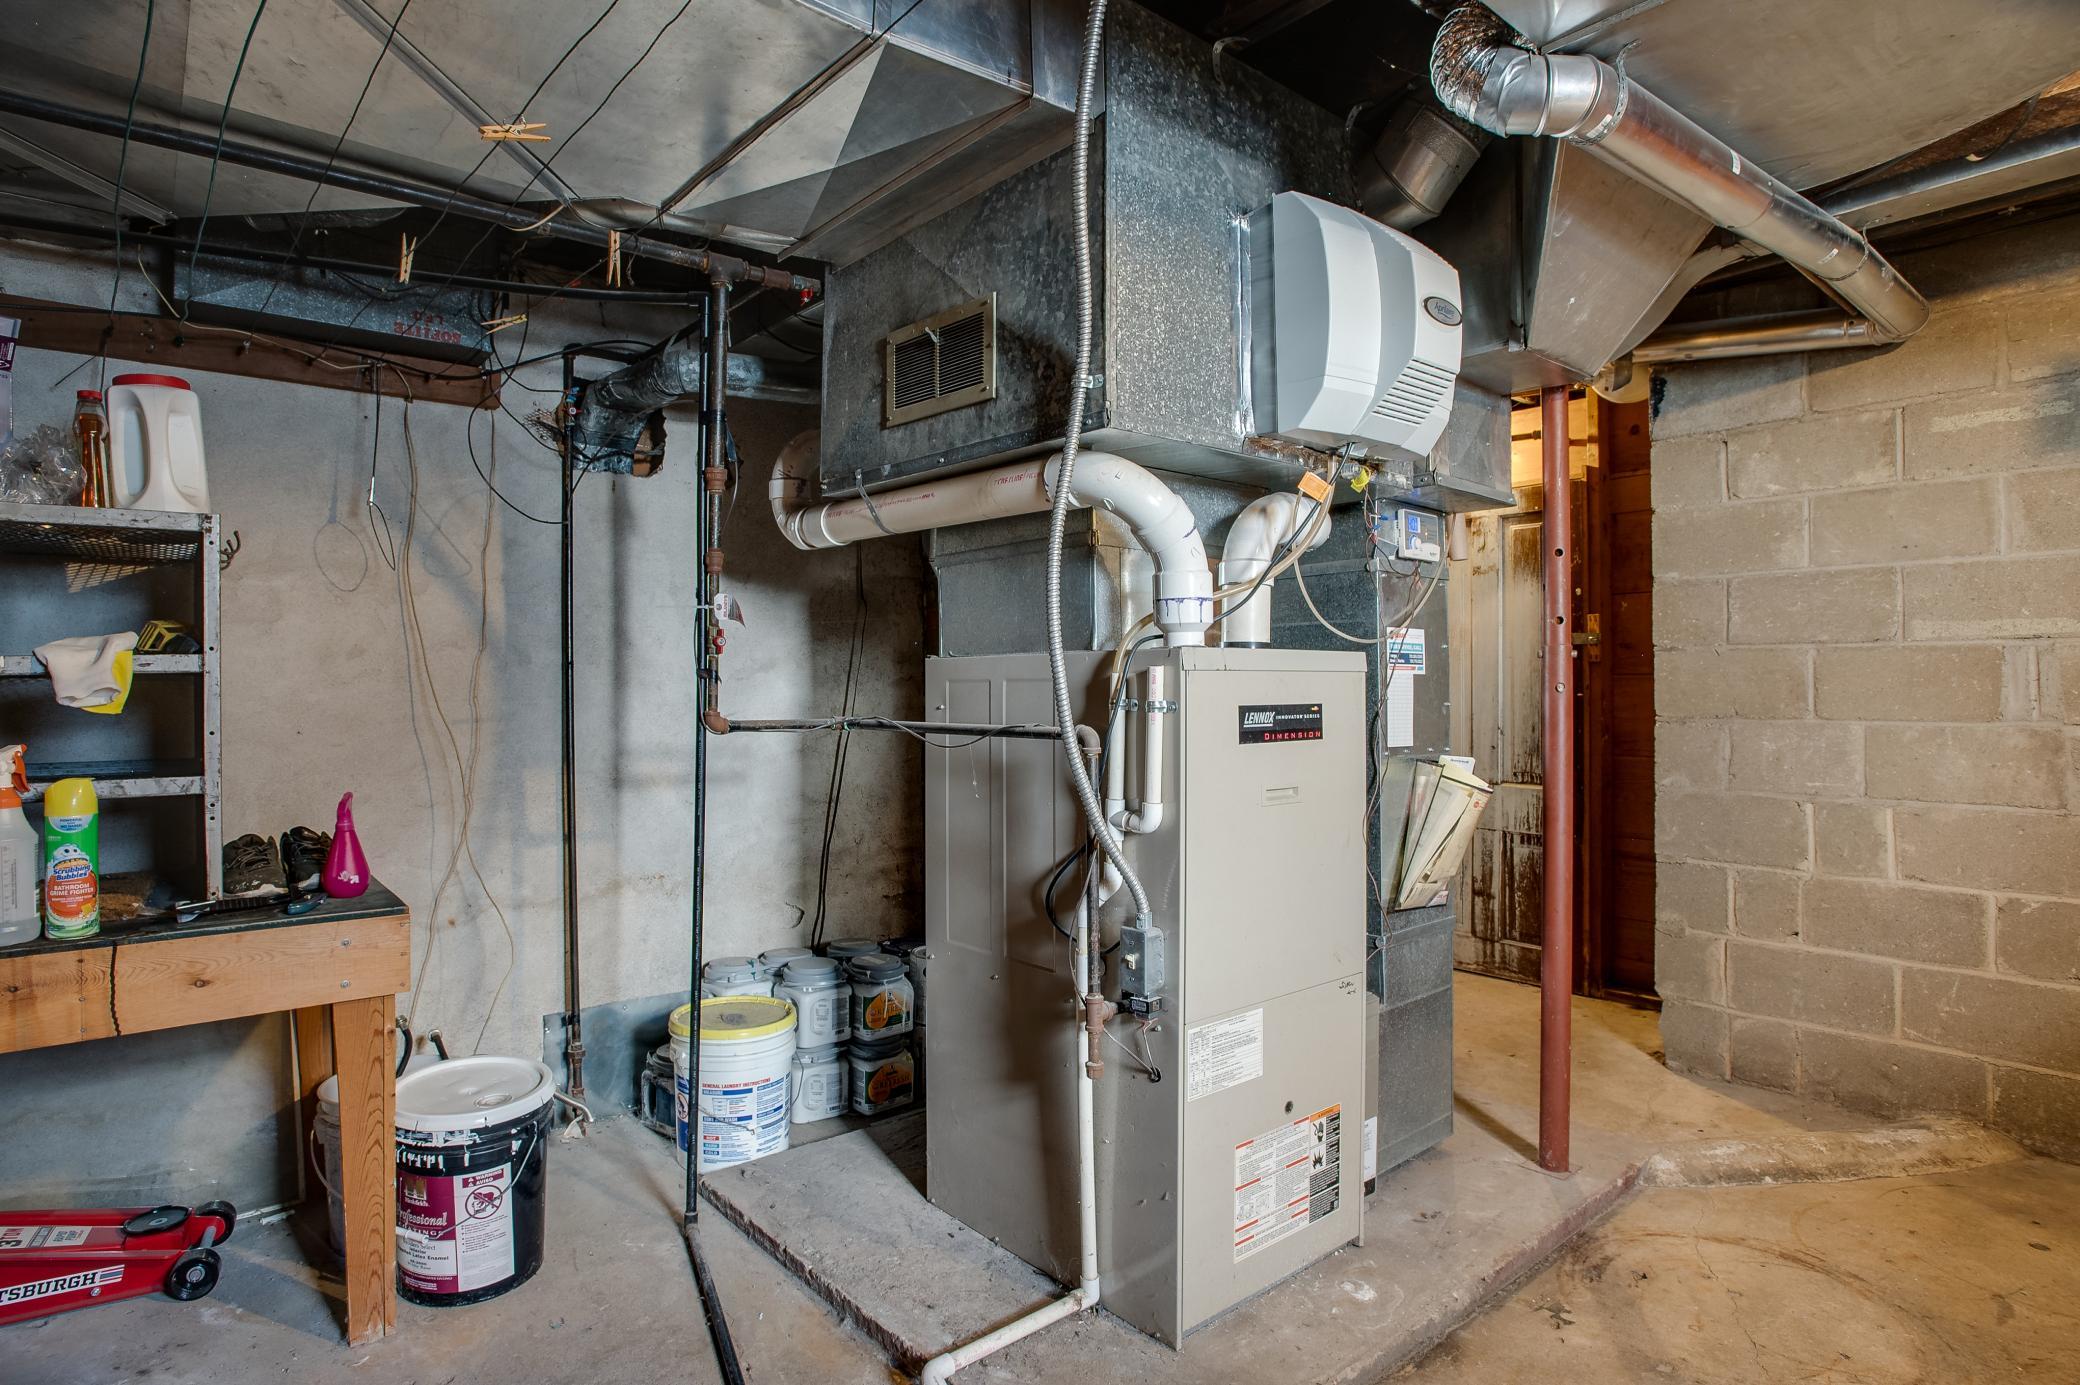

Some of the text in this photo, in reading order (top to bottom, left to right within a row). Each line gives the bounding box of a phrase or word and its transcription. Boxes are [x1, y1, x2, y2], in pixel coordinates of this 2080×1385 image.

[1244, 711, 1275, 724] LENNOX
[53, 864, 91, 875] Scrubbing
[56, 872, 88, 881] Bubbles
[54, 883, 90, 891] BATHROOM
[70, 887, 94, 895] FIGHTER
[743, 1078, 771, 1087] INSTRUCTIONS
[475, 1169, 503, 1181] WARNING
[476, 1177, 494, 1186] AVISO
